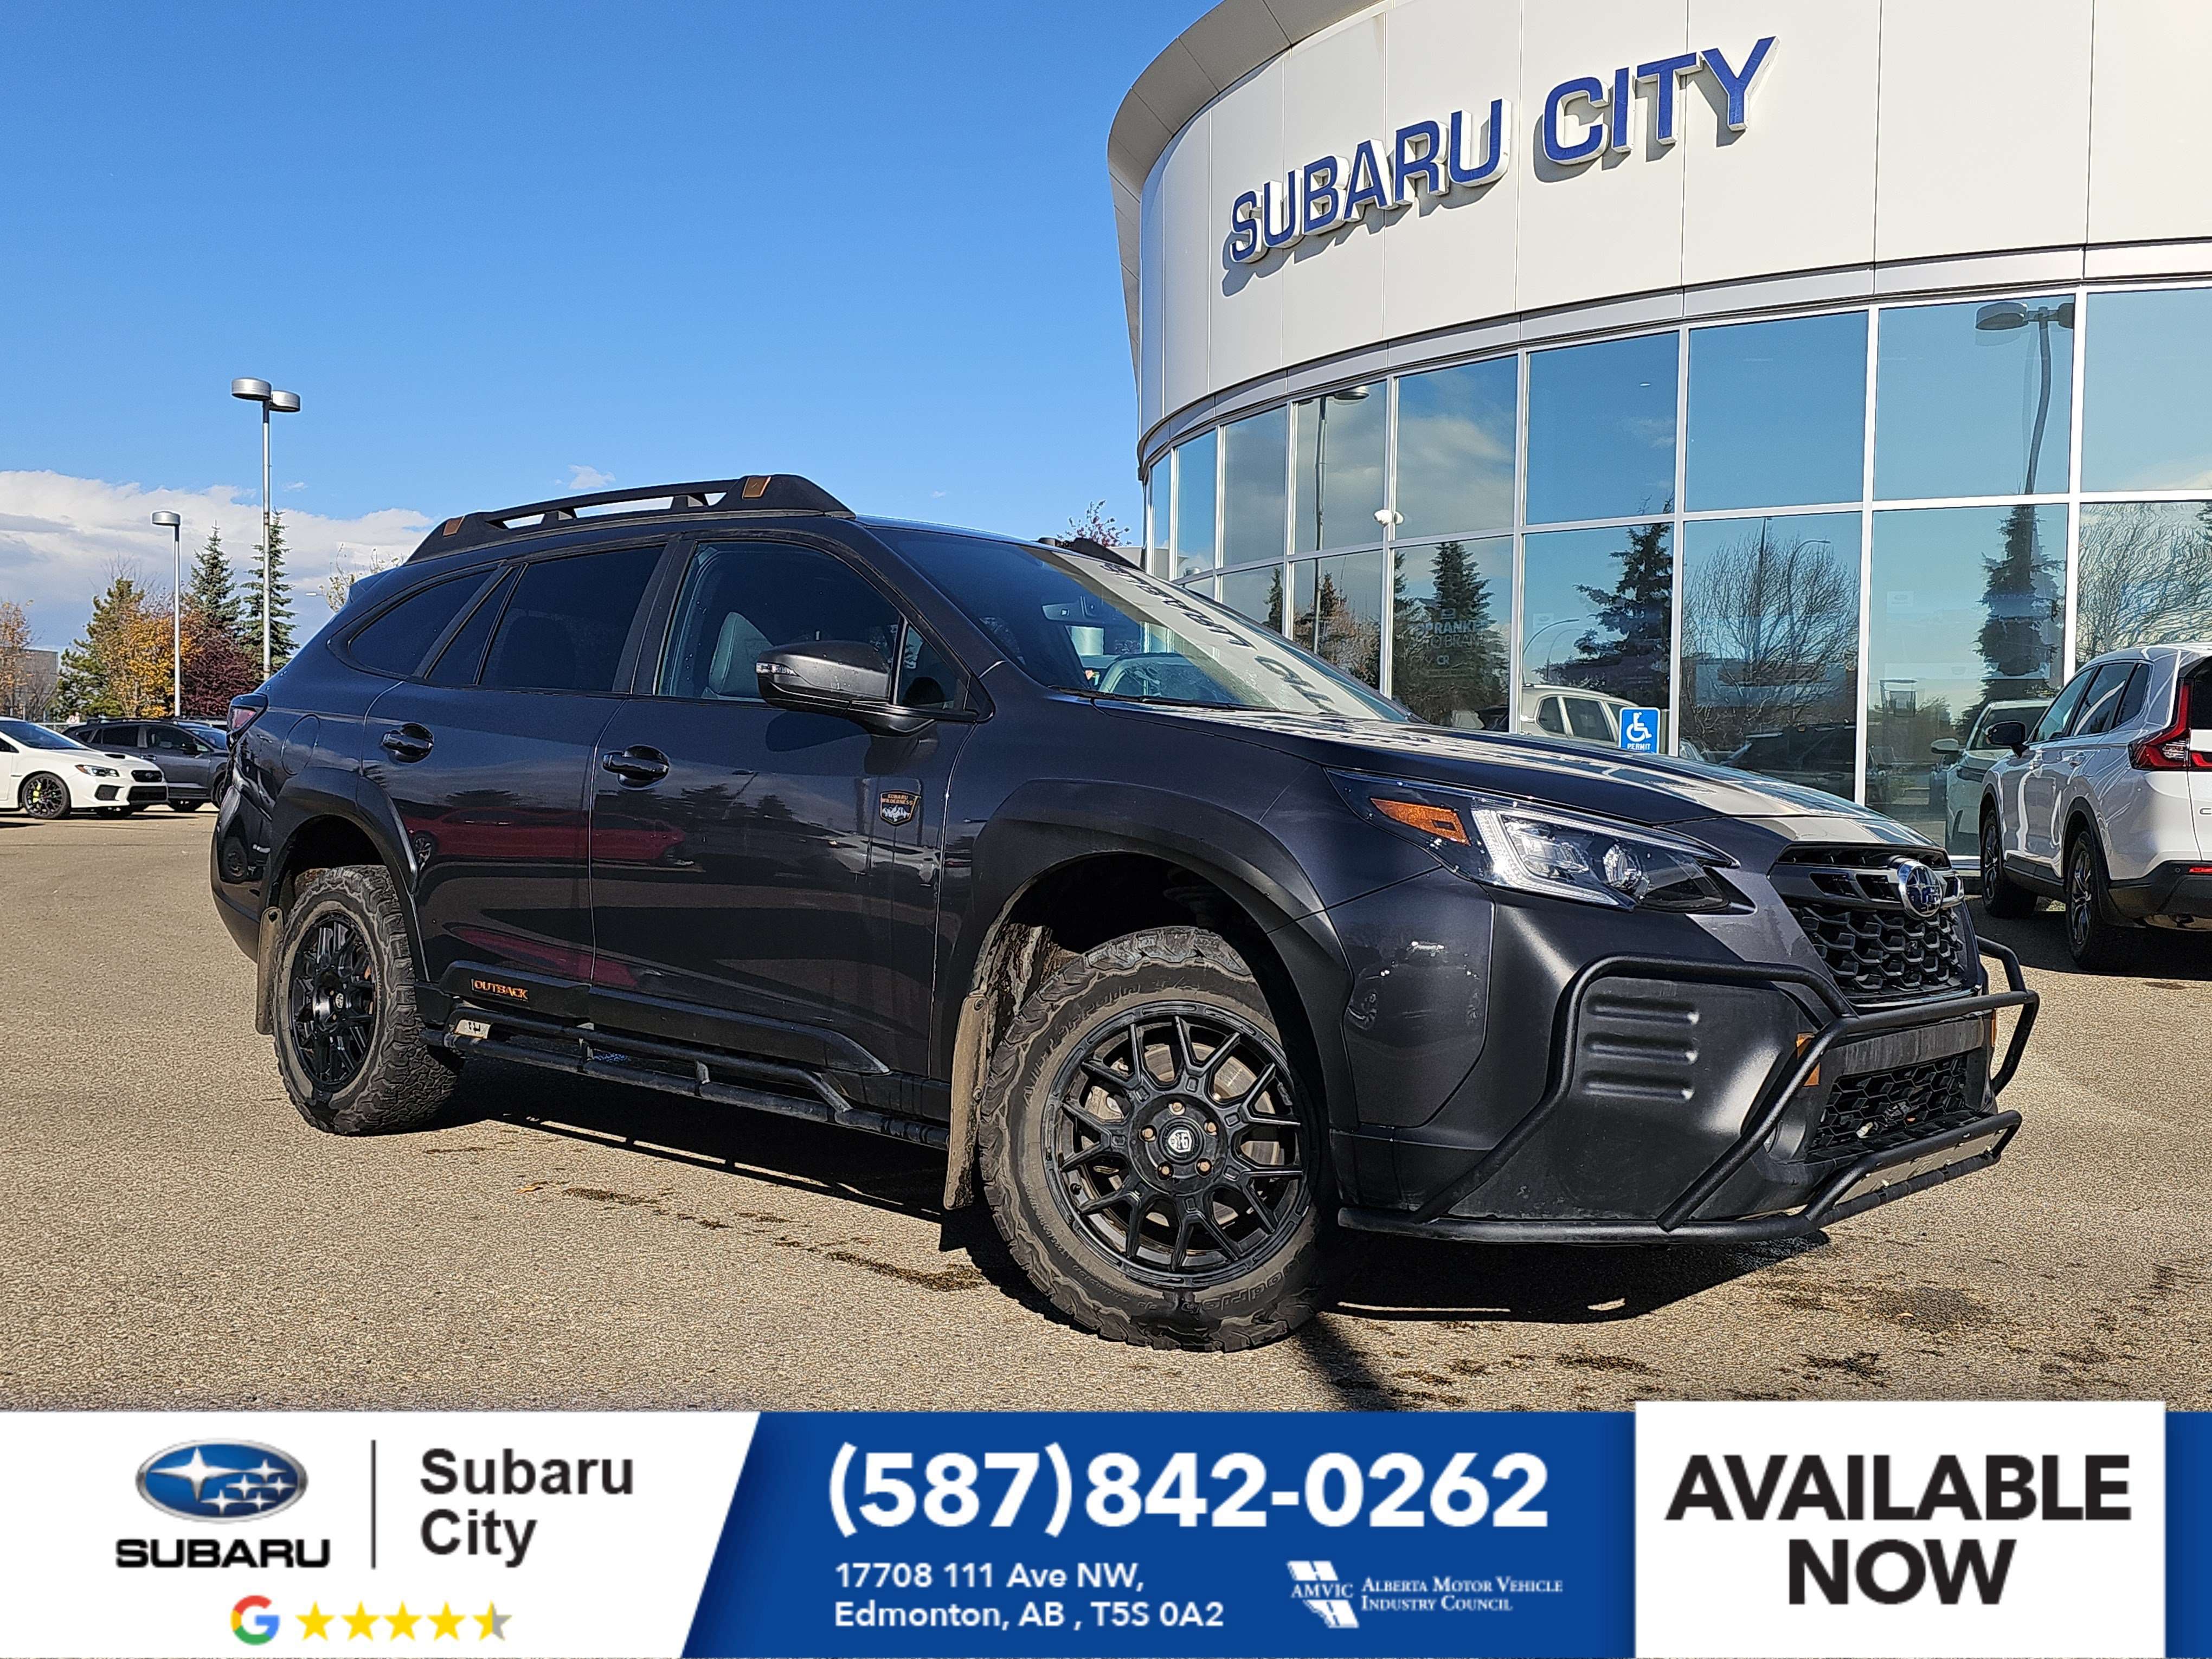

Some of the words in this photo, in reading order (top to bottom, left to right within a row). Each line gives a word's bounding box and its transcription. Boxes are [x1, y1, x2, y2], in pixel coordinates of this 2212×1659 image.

[1231, 98, 1505, 262] SUBARU
[1543, 36, 1778, 163] CITY
[474, 980, 529, 1000] OUTBACK
